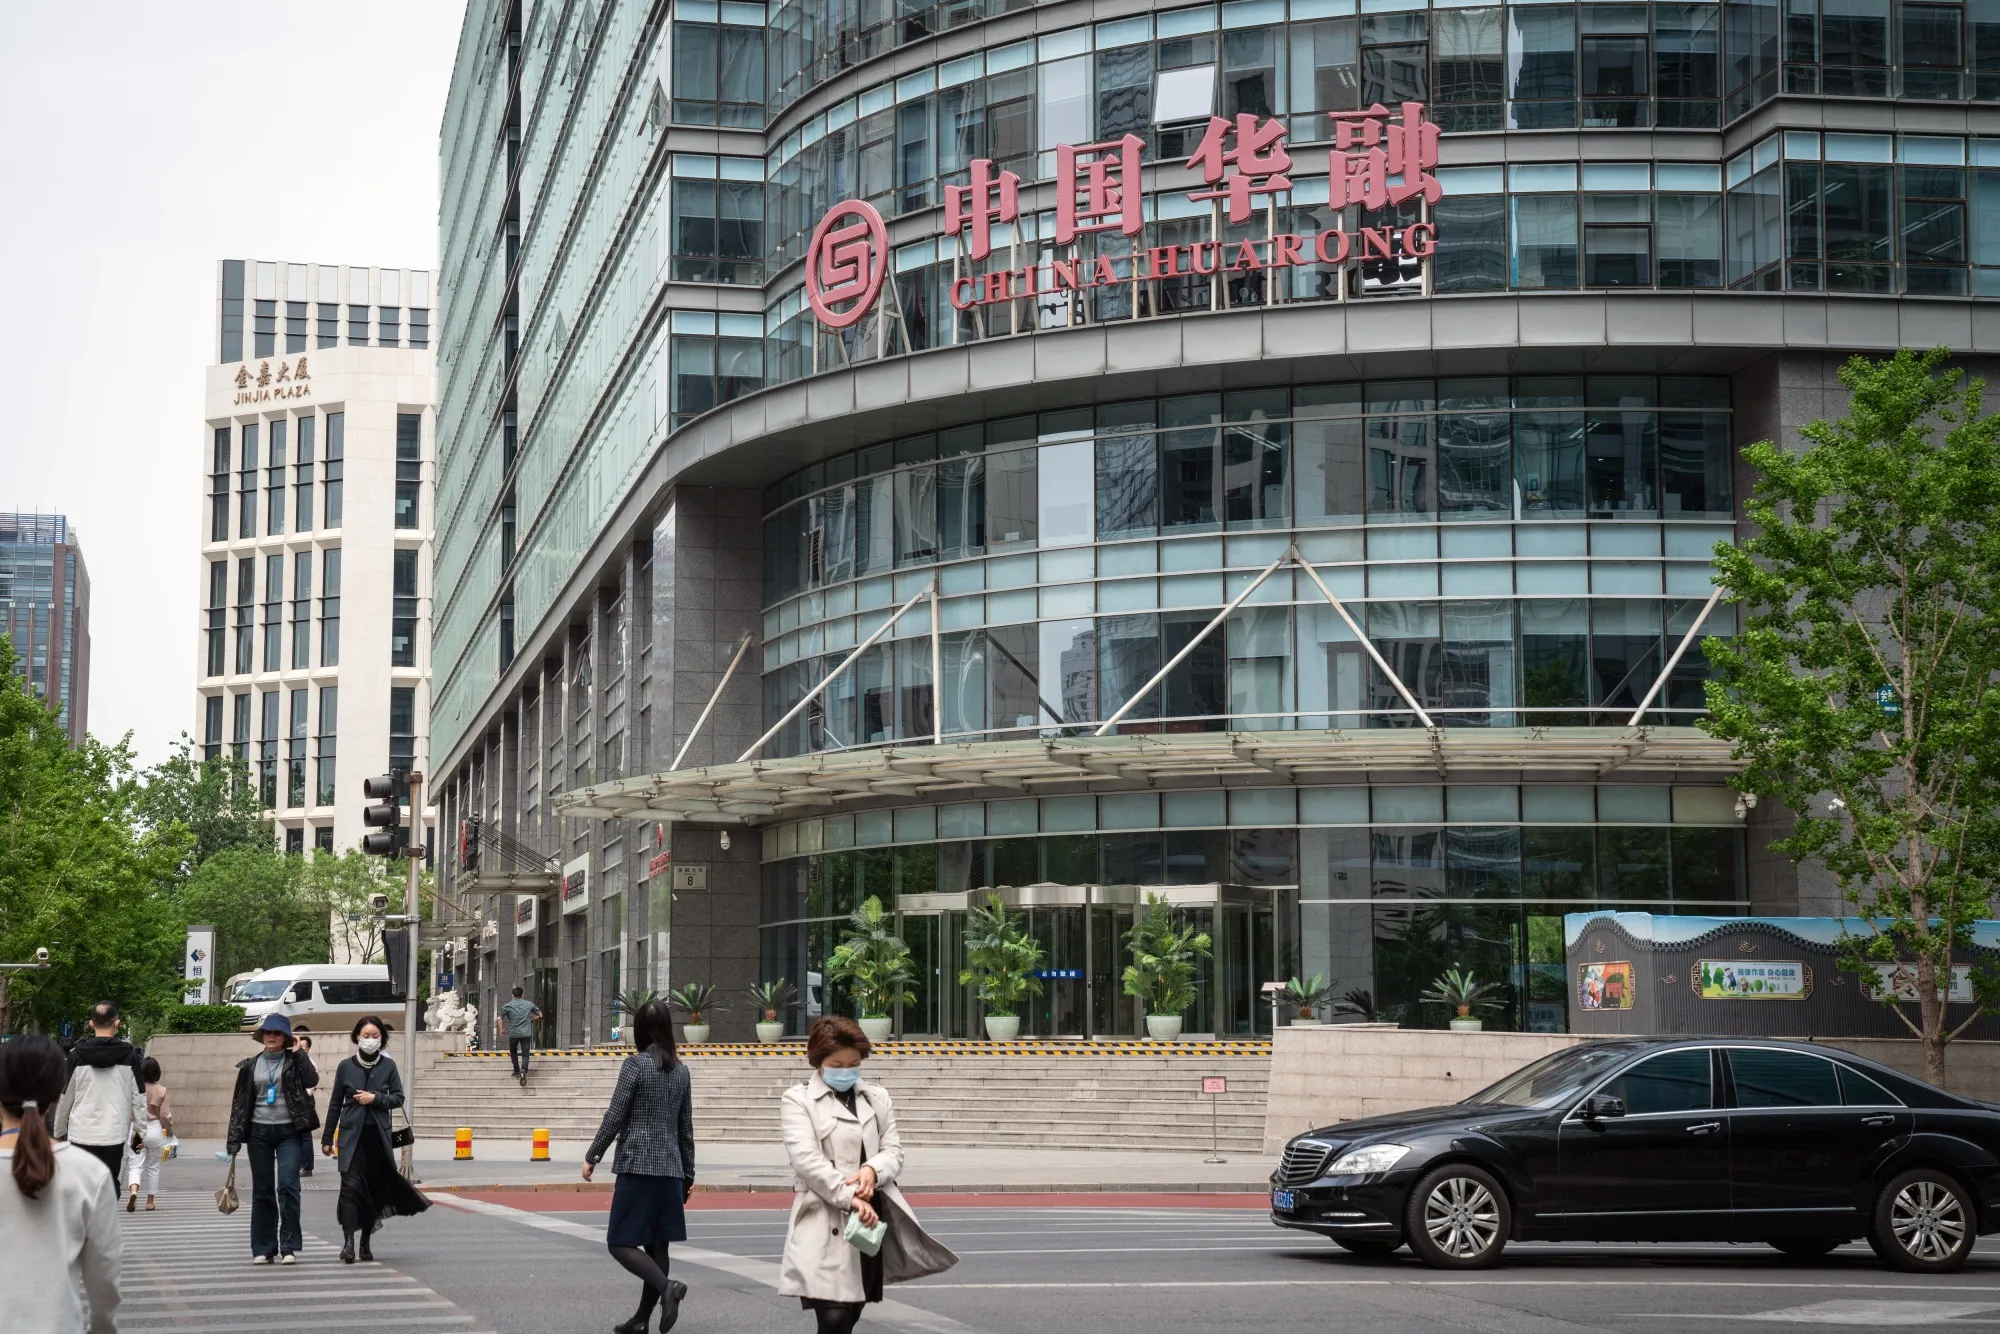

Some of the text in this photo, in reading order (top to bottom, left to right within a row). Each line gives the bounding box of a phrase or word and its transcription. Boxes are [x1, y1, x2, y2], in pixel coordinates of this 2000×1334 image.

[945, 101, 1443, 262] 中国华融
[951, 223, 1439, 310] CHINA HUARONG
[234, 356, 311, 389] 金嘉大厦
[234, 384, 311, 405] JINJIA PLAZA
[687, 876, 694, 886] 8
